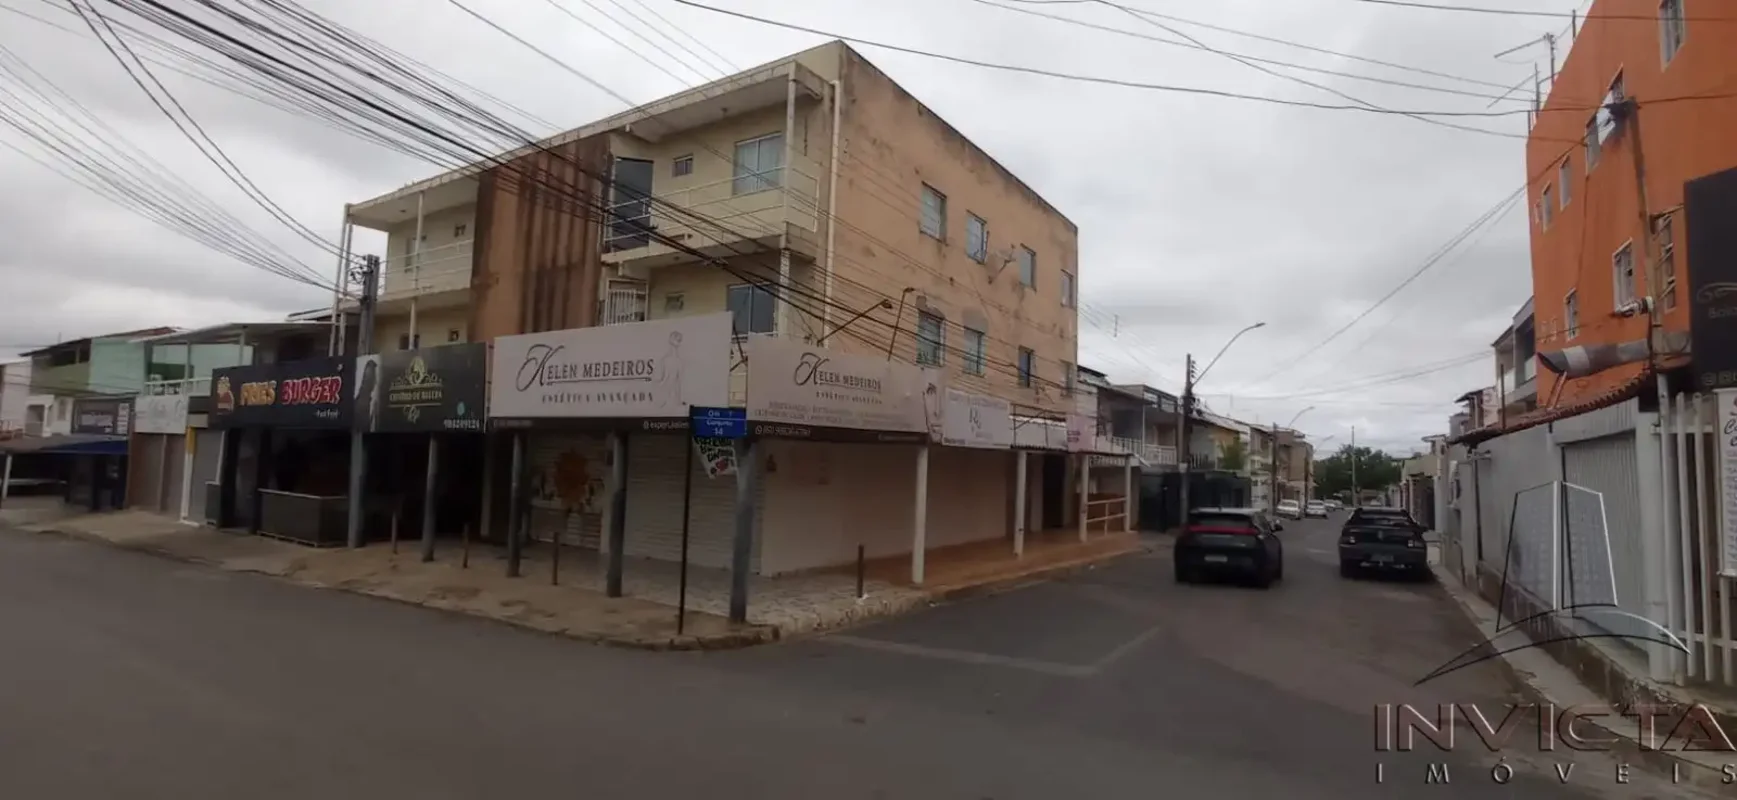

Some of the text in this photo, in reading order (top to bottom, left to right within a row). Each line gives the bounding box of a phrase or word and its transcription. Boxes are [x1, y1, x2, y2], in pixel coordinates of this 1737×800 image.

[516, 344, 655, 392] KELEN MEDEIROS
[794, 352, 882, 391] KELEN MEDEIROS
[239, 375, 342, 406] FRIES BURGER
